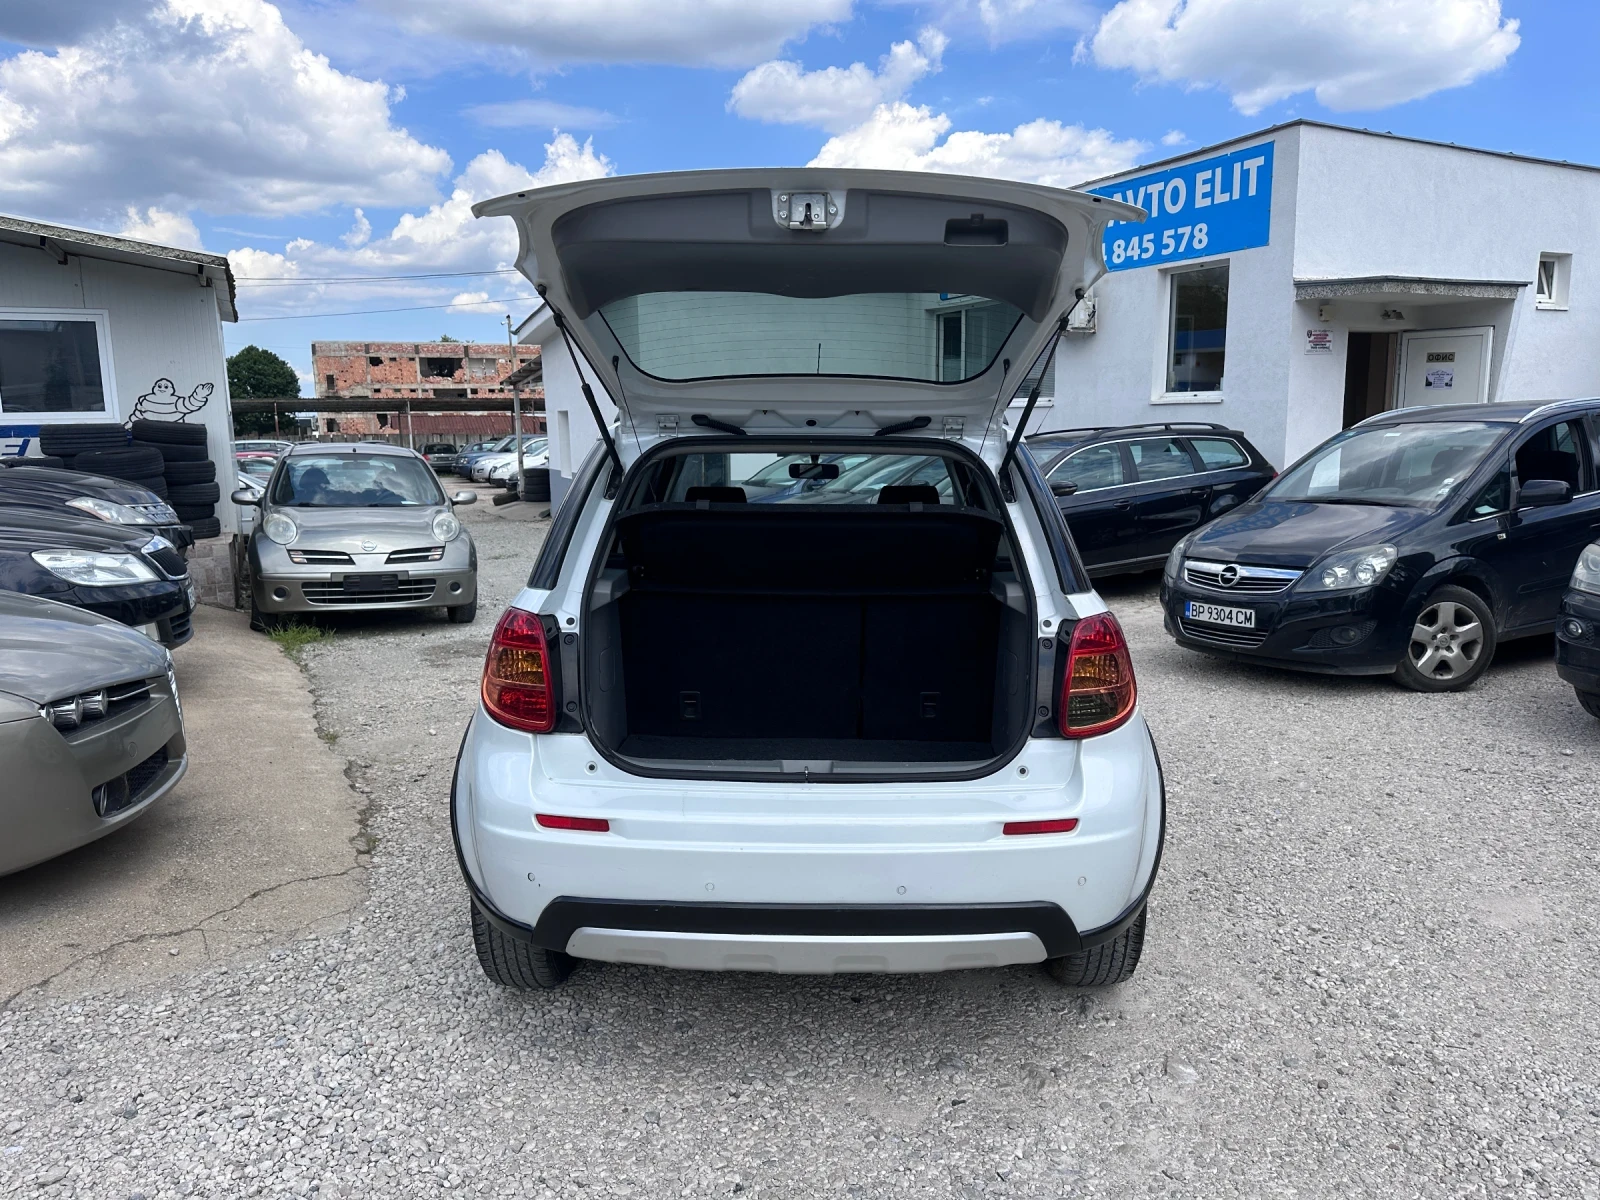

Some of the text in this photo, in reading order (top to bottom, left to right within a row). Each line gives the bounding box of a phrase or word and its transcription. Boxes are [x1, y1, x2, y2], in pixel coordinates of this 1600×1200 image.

[1195, 156, 1264, 208] ELIT
[1111, 233, 1155, 264] 845
[1161, 222, 1209, 256] 578
[1428, 353, 1454, 362] ОФИС
[1191, 604, 1205, 618] BP
[1207, 606, 1233, 623] 9304
[1236, 610, 1253, 625] CM
